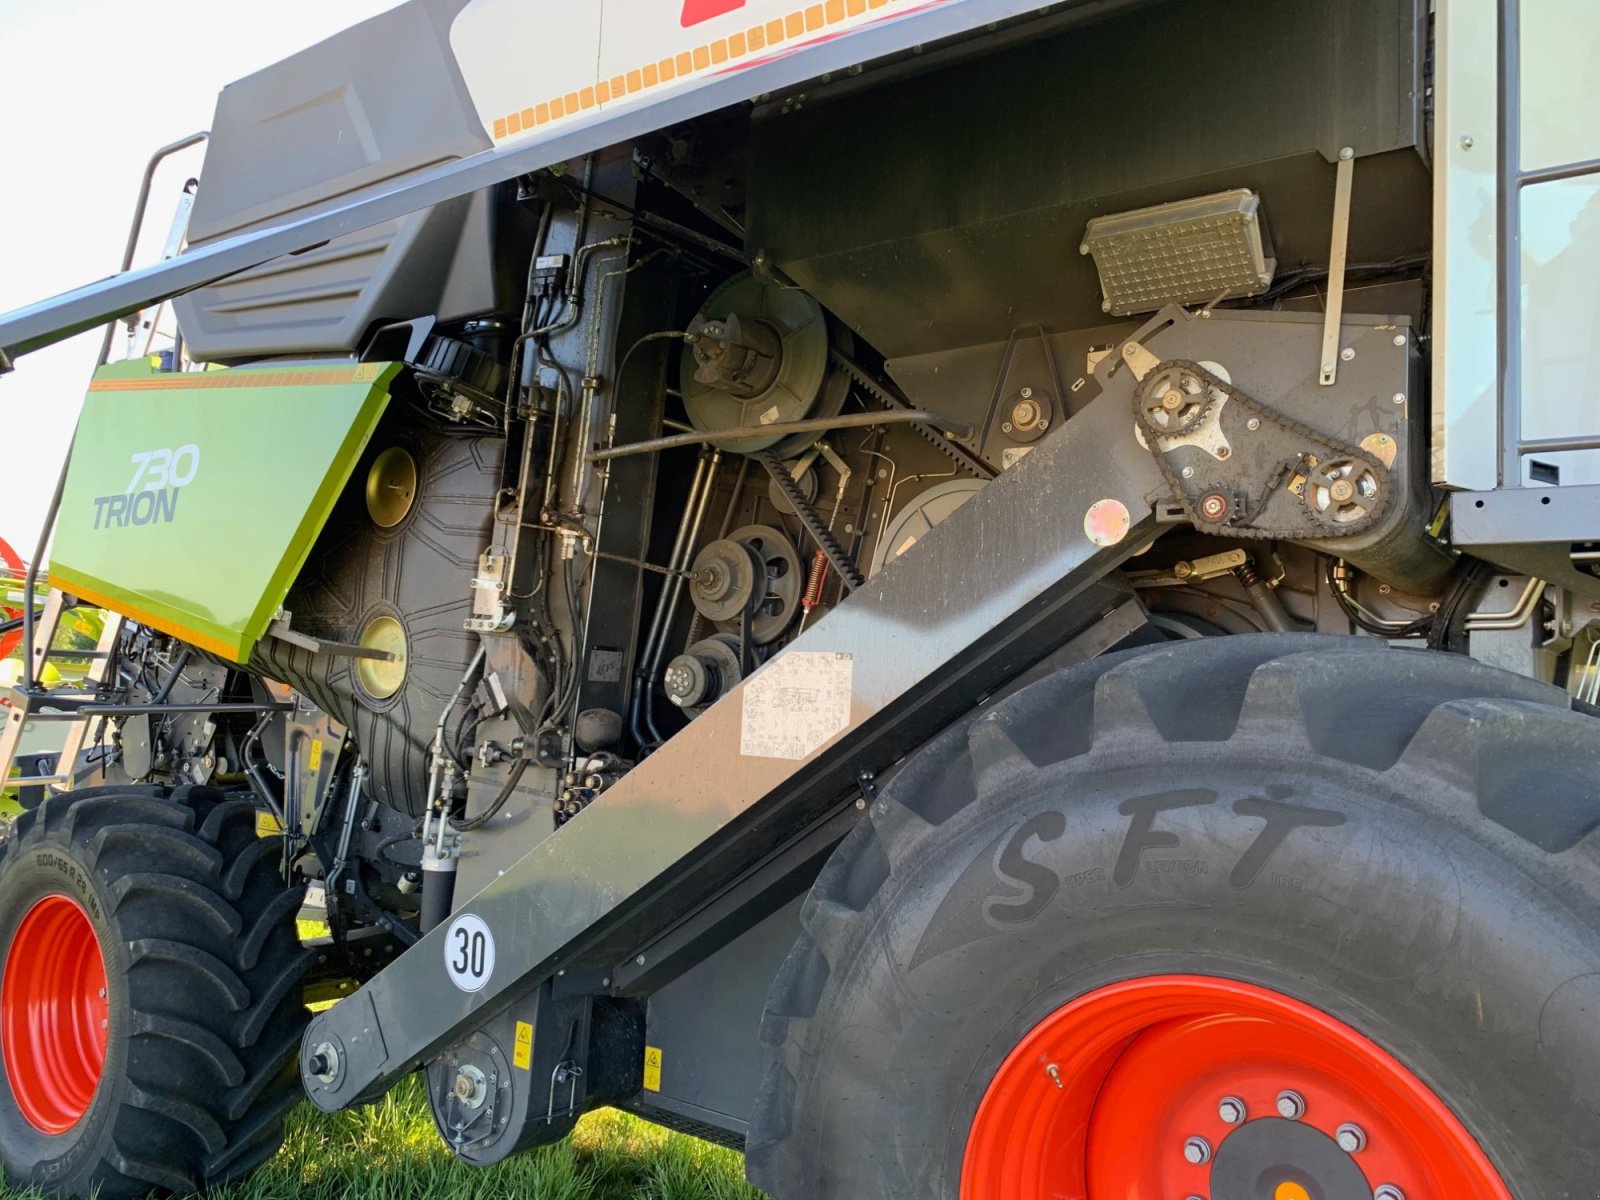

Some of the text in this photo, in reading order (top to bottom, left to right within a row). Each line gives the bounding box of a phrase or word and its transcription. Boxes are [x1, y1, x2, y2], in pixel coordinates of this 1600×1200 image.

[126, 443, 200, 494] 730
[93, 487, 180, 530] TRION
[37, 853, 69, 874] 600/65
[453, 927, 486, 978] 30
